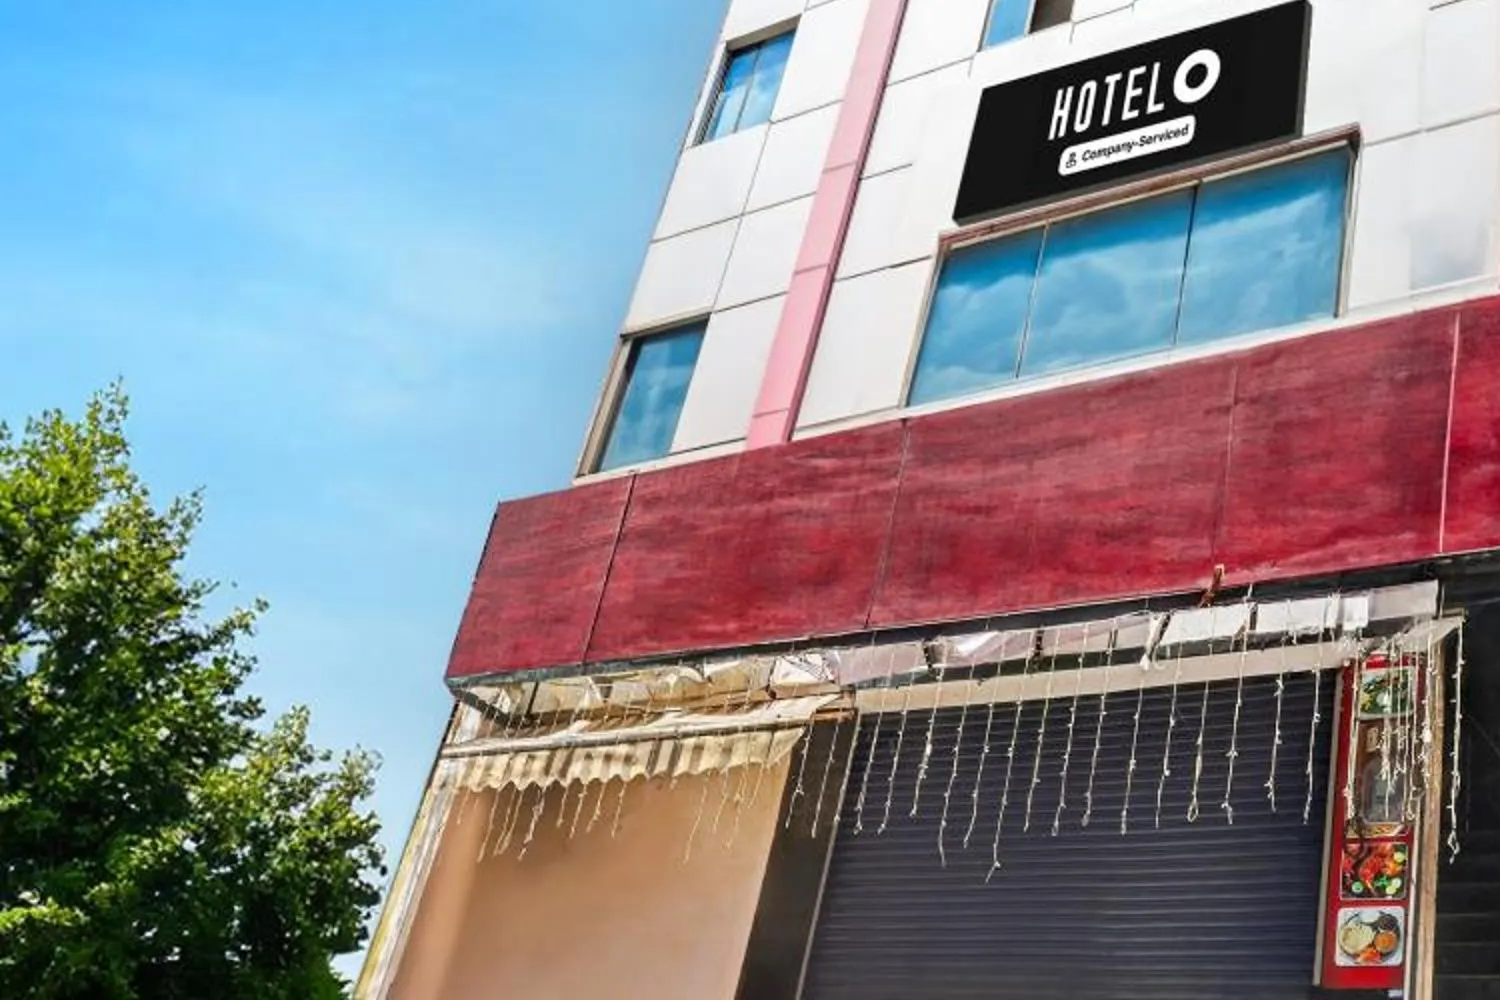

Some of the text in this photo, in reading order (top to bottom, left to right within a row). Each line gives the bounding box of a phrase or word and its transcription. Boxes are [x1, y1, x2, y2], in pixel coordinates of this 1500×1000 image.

[1048, 49, 1221, 140] HOTEL O
[1081, 124, 1189, 161] Company-Serviced
